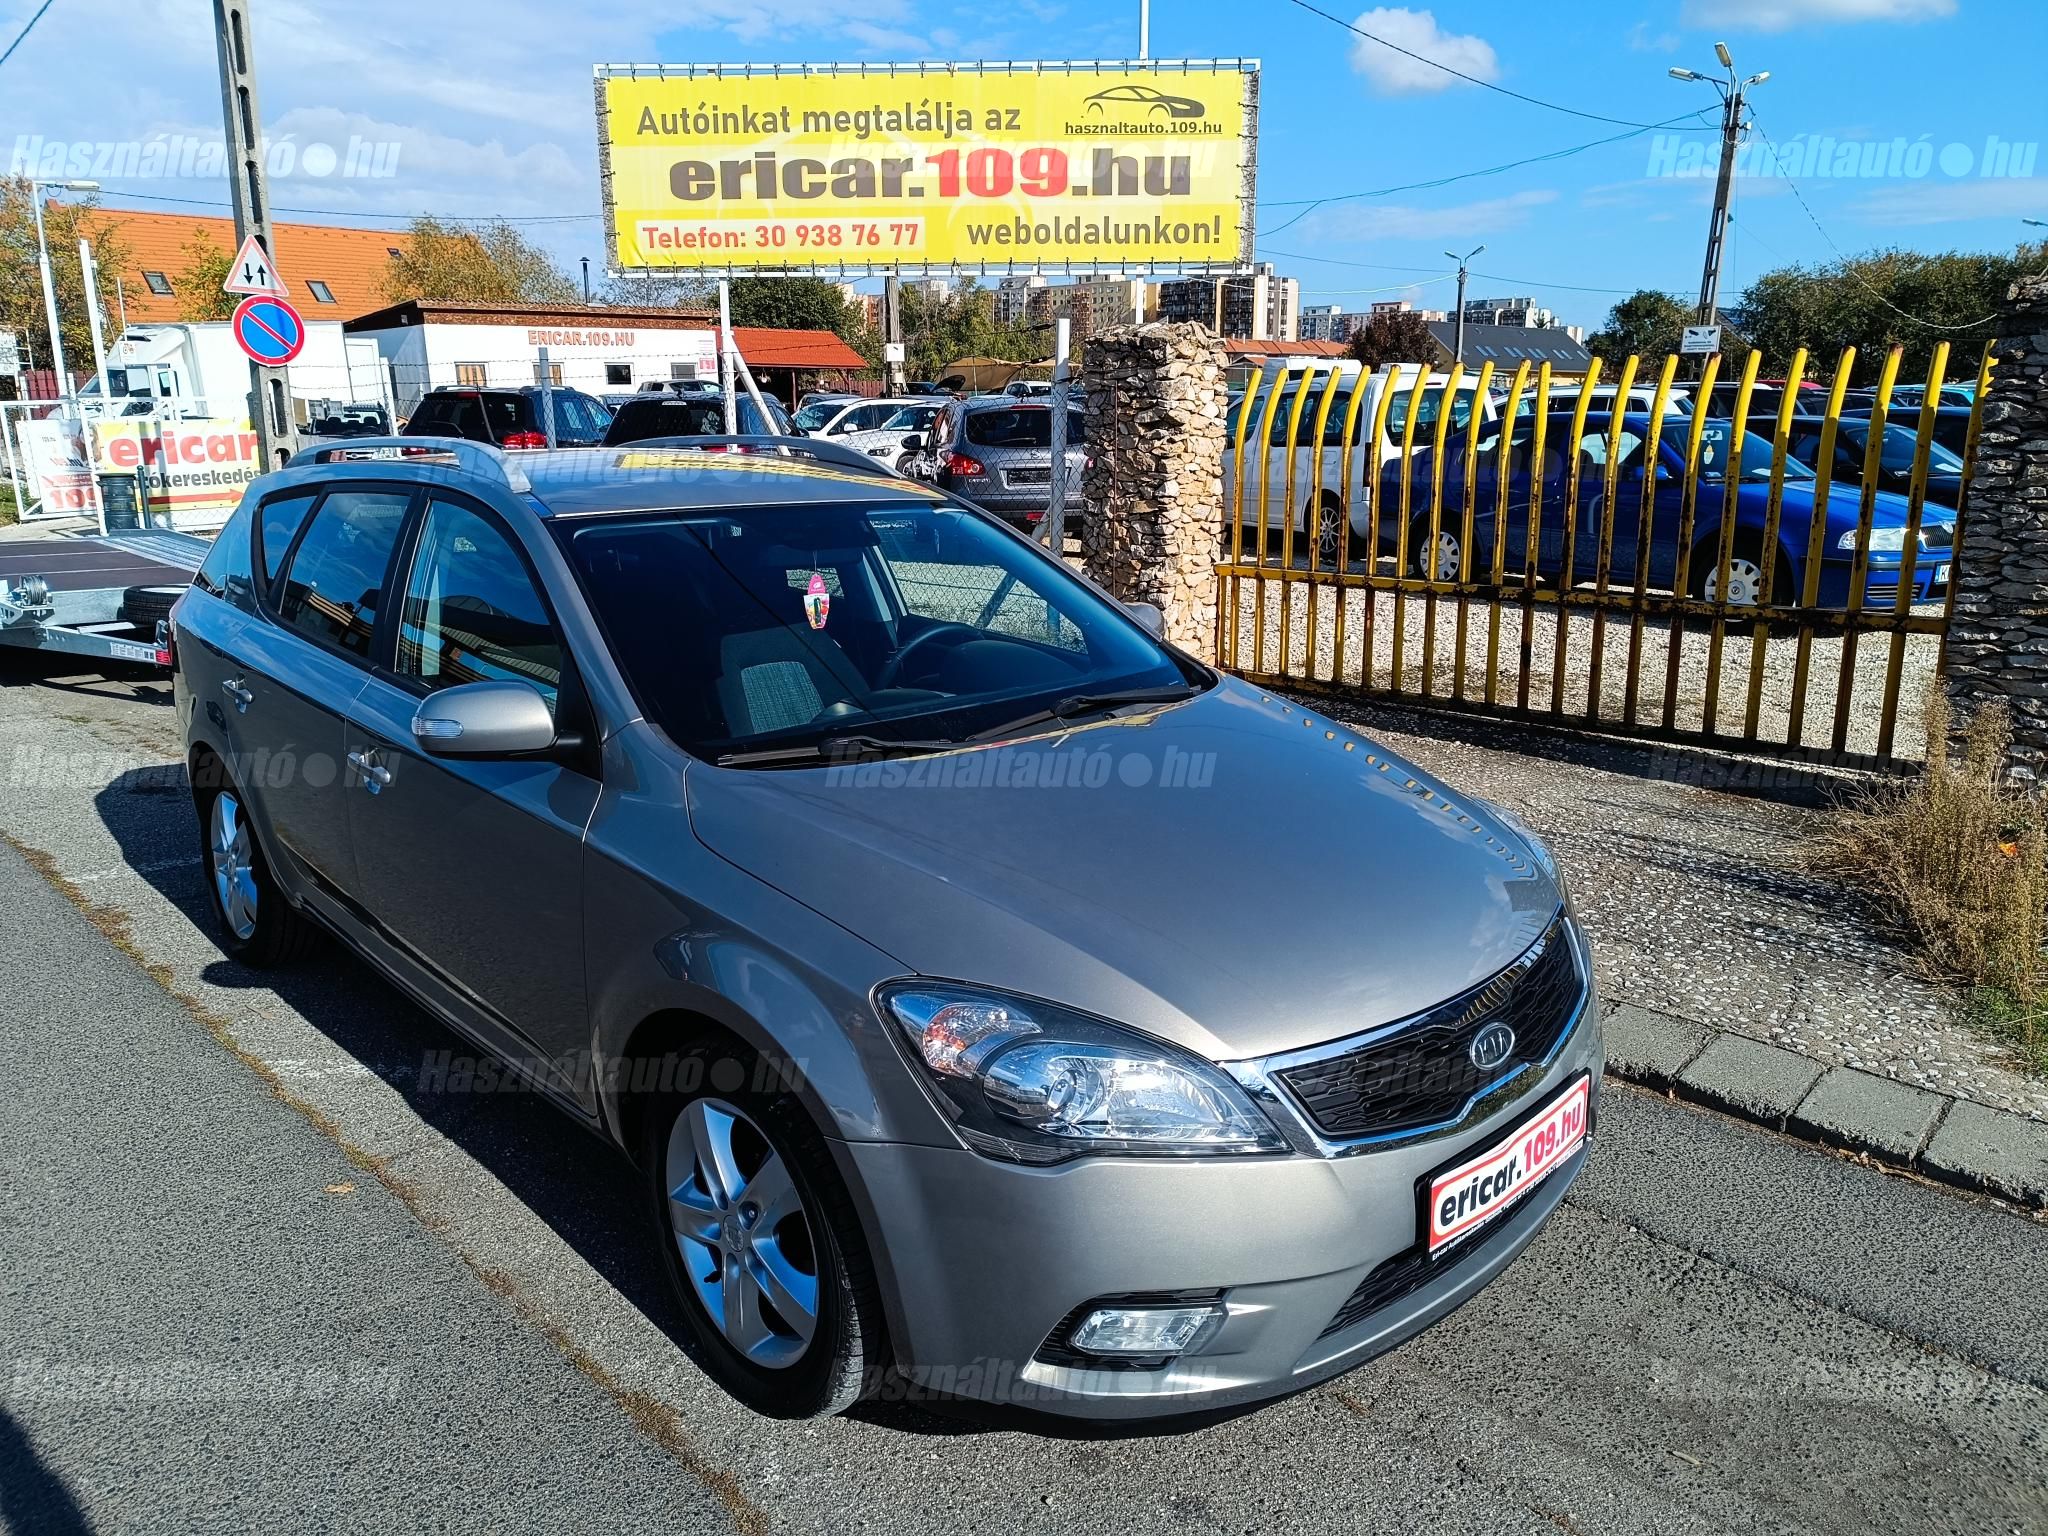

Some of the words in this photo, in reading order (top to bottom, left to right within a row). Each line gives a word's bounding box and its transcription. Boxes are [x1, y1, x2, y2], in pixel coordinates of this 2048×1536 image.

[637, 101, 790, 135] Autóinkat
[803, 99, 973, 139] megtalálja
[985, 109, 1021, 131] az
[1065, 121, 1223, 134] hasznaltauto.109.hu
[669, 148, 1191, 200] ericar.109.hu
[643, 227, 746, 248] Telefon:
[755, 225, 785, 247] 30
[796, 225, 842, 247] 938
[852, 224, 880, 246] 76
[889, 224, 918, 246] 77
[967, 215, 1221, 245] weboldalunkon!
[528, 330, 635, 346] ERICAR.109.HU
[109, 431, 260, 467] ericar
[1440, 1102, 1582, 1227] ericar.109.hu
